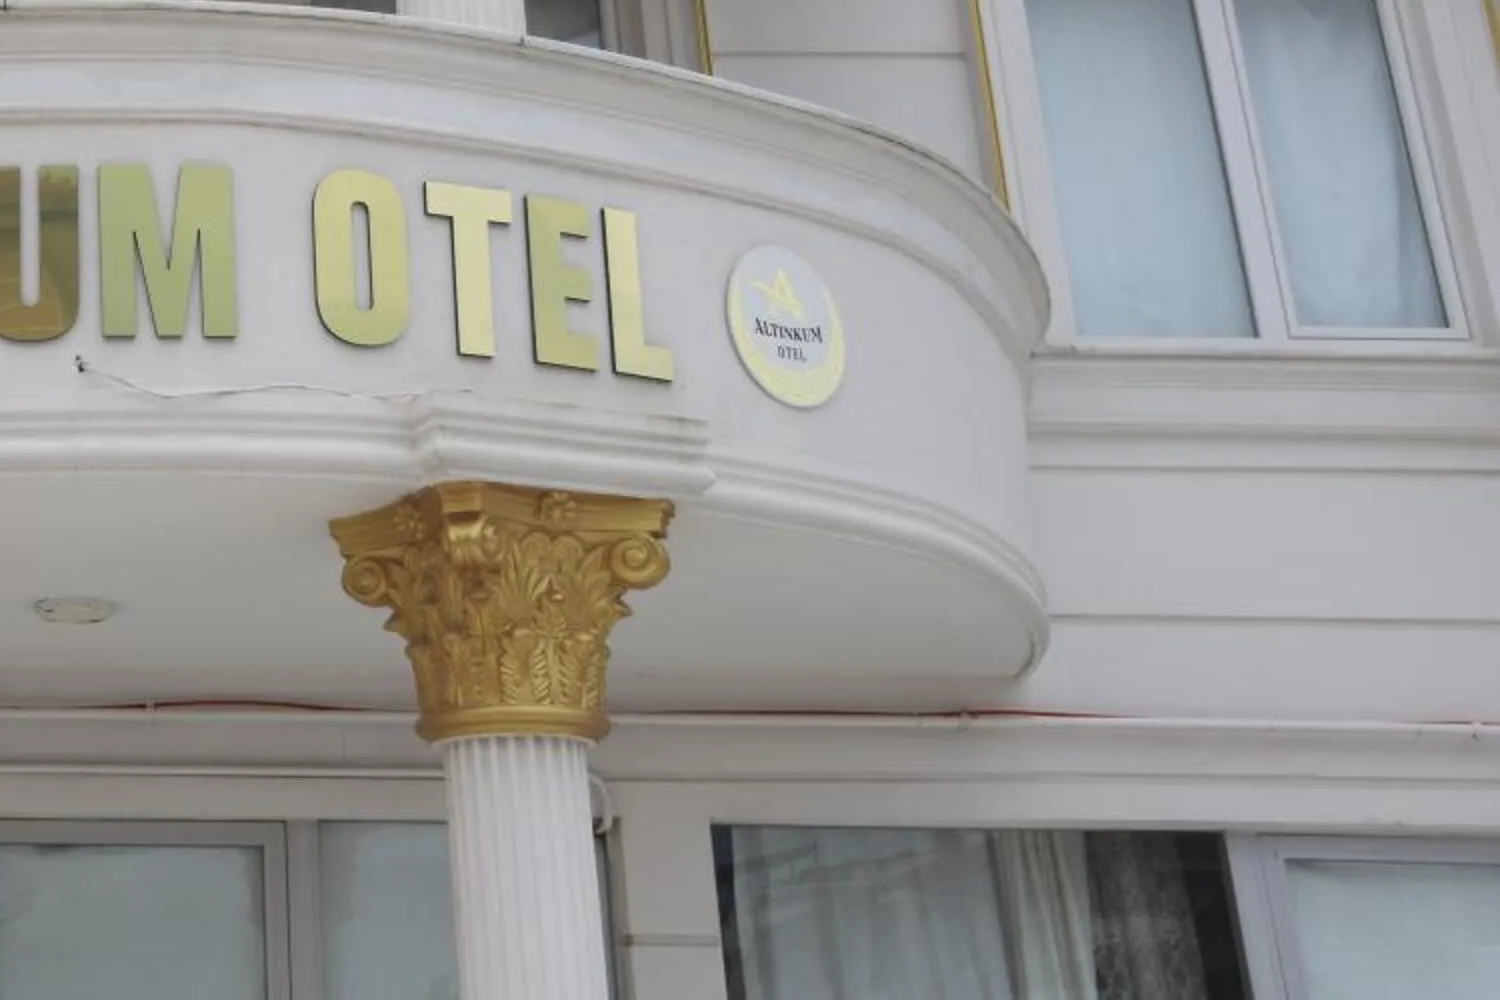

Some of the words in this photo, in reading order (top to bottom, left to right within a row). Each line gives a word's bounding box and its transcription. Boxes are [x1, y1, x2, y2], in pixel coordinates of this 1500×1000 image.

[311, 168, 674, 382] OTEL
[755, 316, 823, 344] ALTINKUM
[776, 345, 807, 363] OTEL
